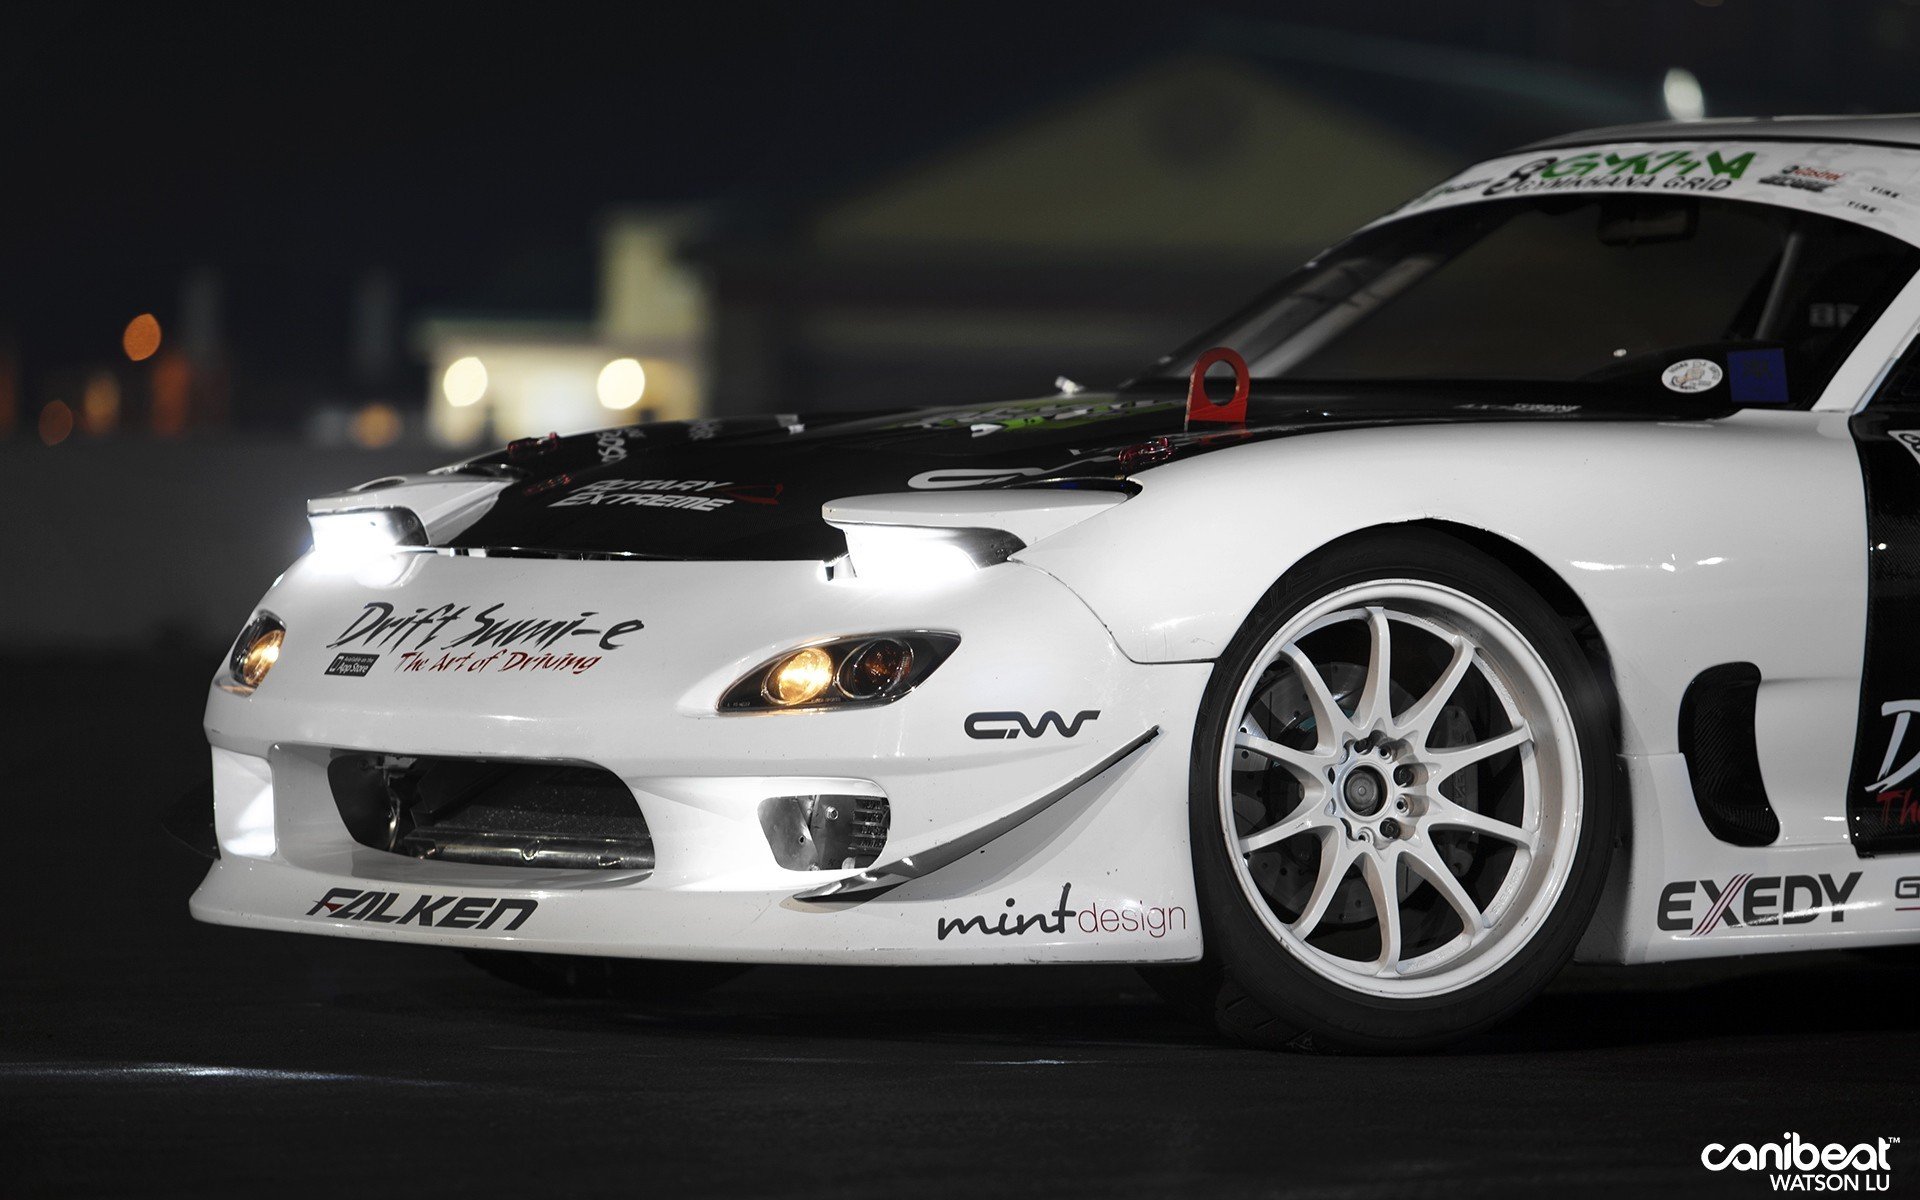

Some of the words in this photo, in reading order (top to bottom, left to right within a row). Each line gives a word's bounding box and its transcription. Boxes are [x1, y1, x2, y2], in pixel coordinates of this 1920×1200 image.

[1662, 175, 1732, 193] GRID
[568, 479, 735, 495] ROTARY
[547, 491, 735, 512] EXTREME
[326, 602, 471, 656] Drift
[394, 651, 430, 672] The
[428, 652, 470, 674] Art
[467, 649, 508, 674] of
[498, 651, 603, 675] Driving
[306, 887, 538, 931] FALKEN
[1657, 872, 1863, 935] EXEDY
